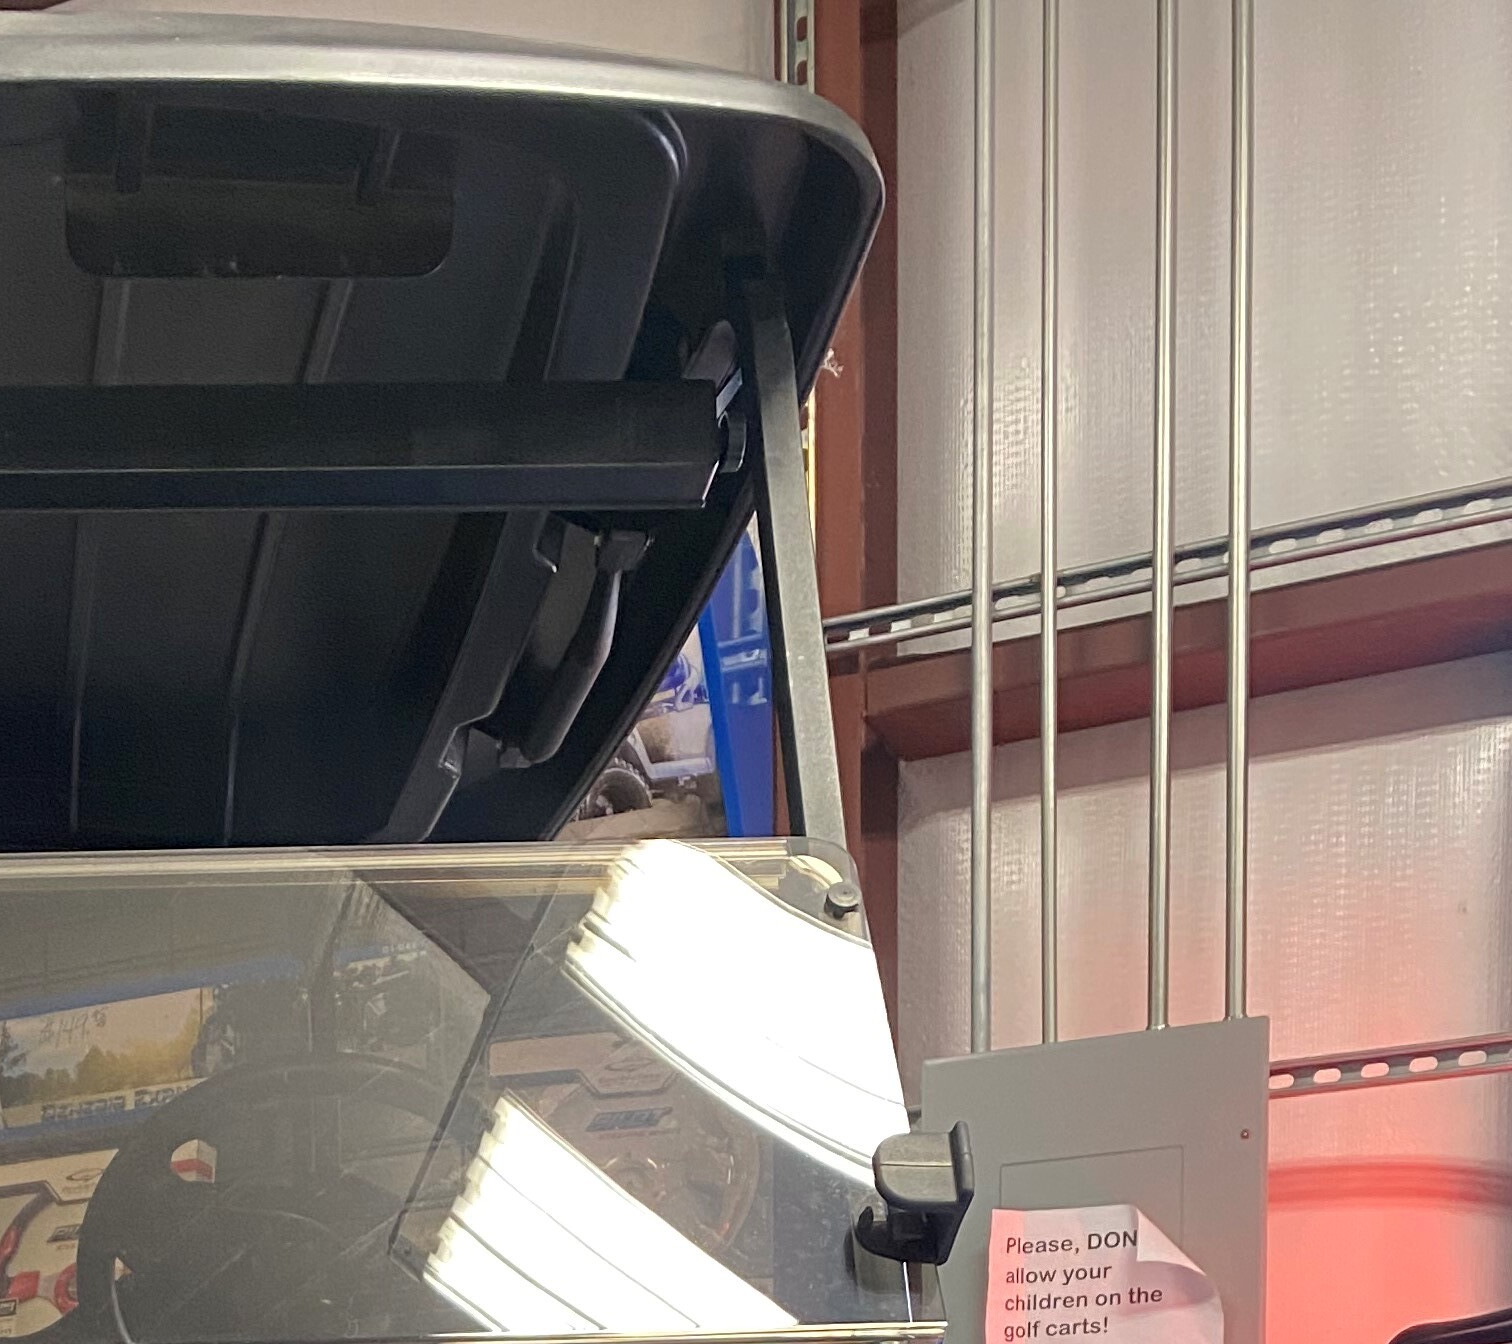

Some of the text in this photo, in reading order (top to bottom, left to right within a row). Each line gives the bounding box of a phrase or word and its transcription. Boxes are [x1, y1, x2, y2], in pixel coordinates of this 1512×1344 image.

[1005, 1229, 1138, 1255] Please, DON
[1005, 1265, 1113, 1286] allow your
[1004, 1286, 1164, 1312] children on the
[1003, 1316, 1109, 1342] golf carts!
